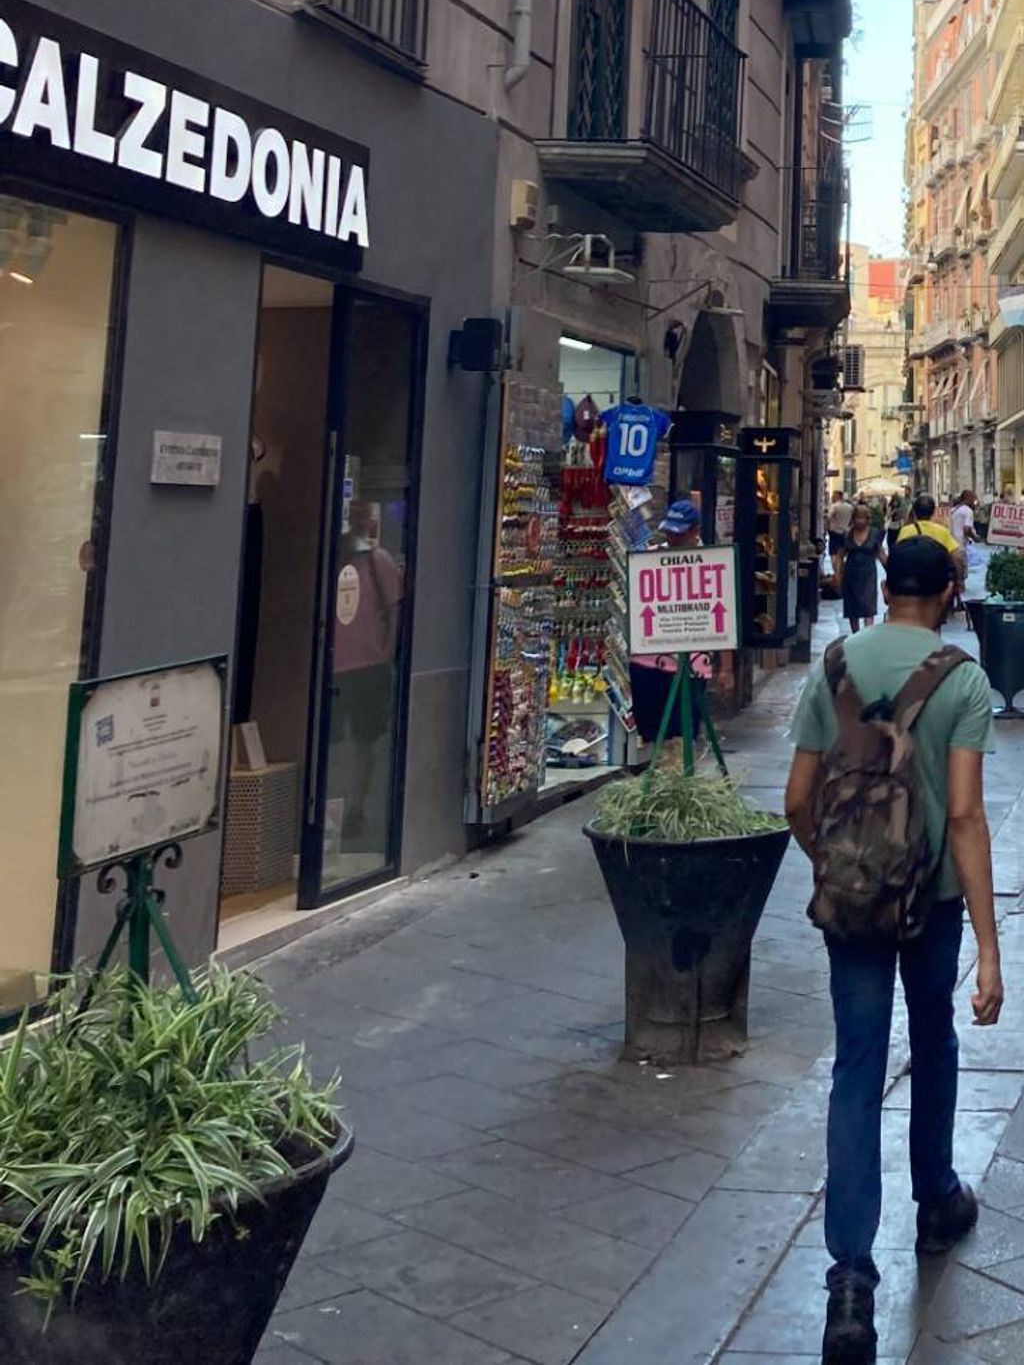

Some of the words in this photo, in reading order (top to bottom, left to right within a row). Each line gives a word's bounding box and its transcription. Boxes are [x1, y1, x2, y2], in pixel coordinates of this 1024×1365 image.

[619, 422, 649, 457] 10
[660, 554, 703, 566] CHIAIA
[638, 563, 726, 603] OUTLET
